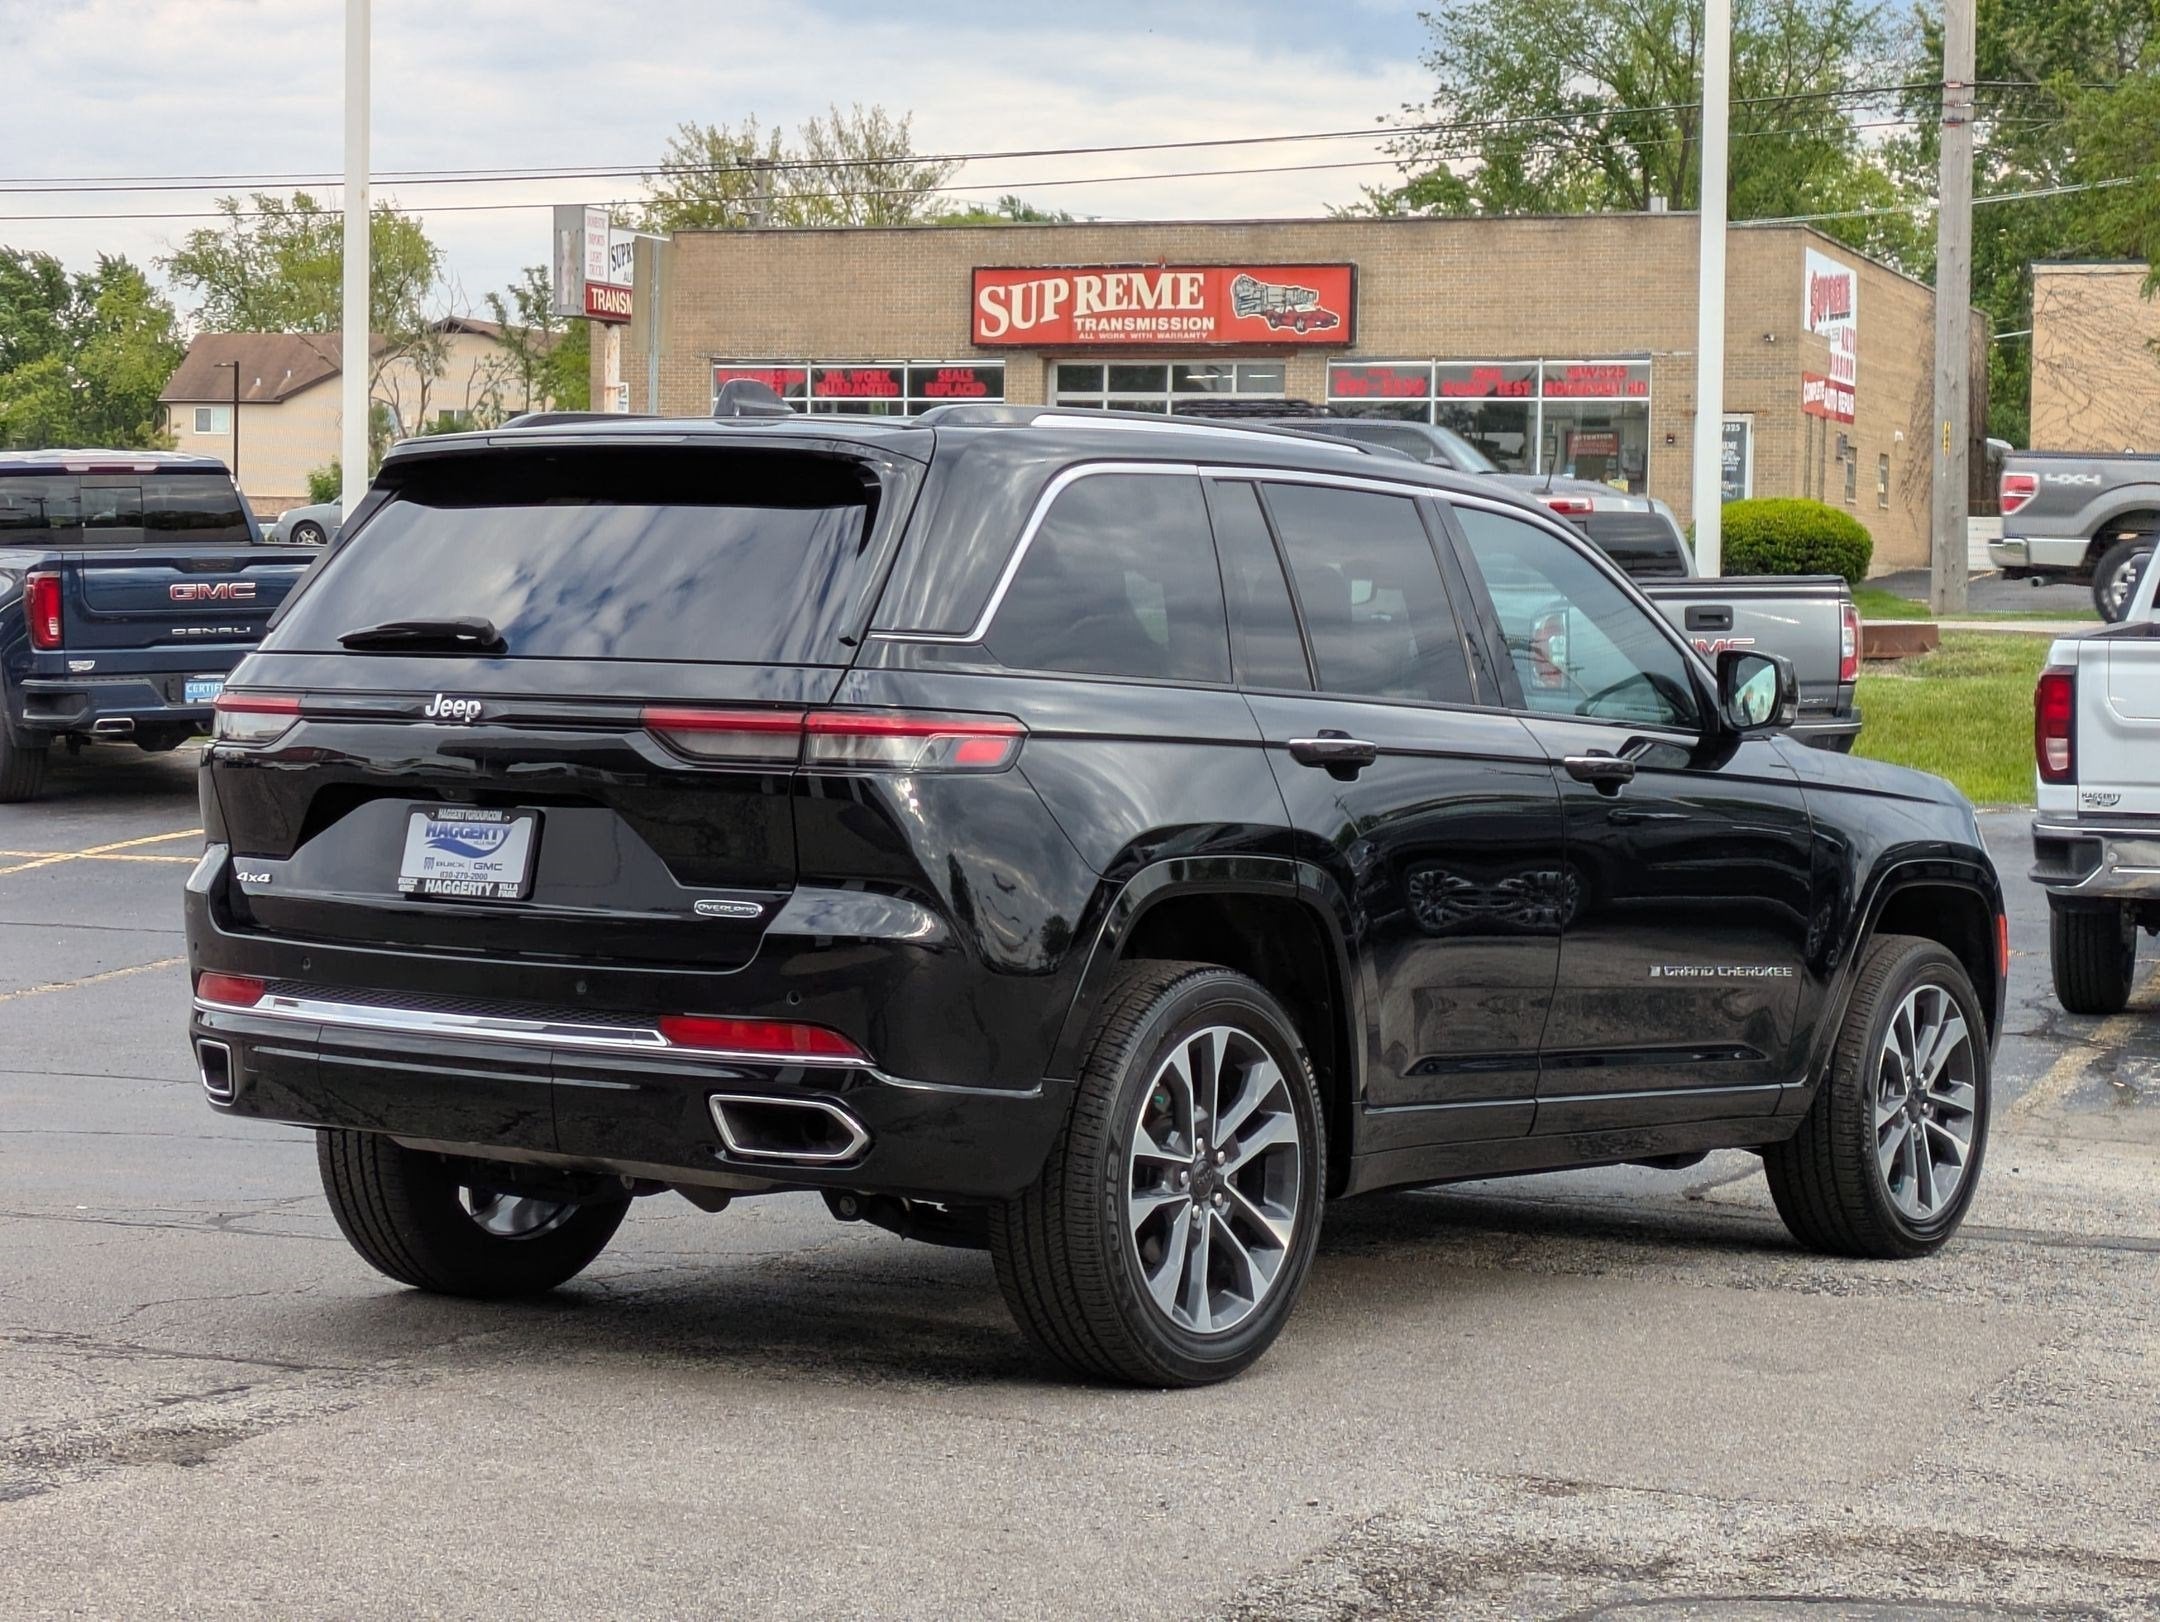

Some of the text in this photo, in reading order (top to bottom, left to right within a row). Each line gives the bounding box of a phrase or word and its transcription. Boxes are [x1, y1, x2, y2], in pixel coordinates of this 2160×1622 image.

[611, 242, 634, 272] SUPR
[979, 272, 1204, 338] SUPREME
[1074, 316, 1215, 332] TRANSMISSION
[1079, 331, 1209, 340] ALL WORK WITH WARRANTY
[850, 370, 892, 383] WORK
[1496, 380, 1532, 396] TEST
[170, 582, 256, 600] GMC
[172, 626, 251, 635] DENALI
[425, 693, 482, 723] Jeep
[425, 822, 514, 841] HAGGERTY
[473, 862, 503, 871] GMC
[236, 871, 272, 883] 4x4
[424, 879, 494, 896] HAGGERTY
[499, 883, 519, 891] VILLA
[1664, 965, 1793, 977] GRAND CHEROKEE
